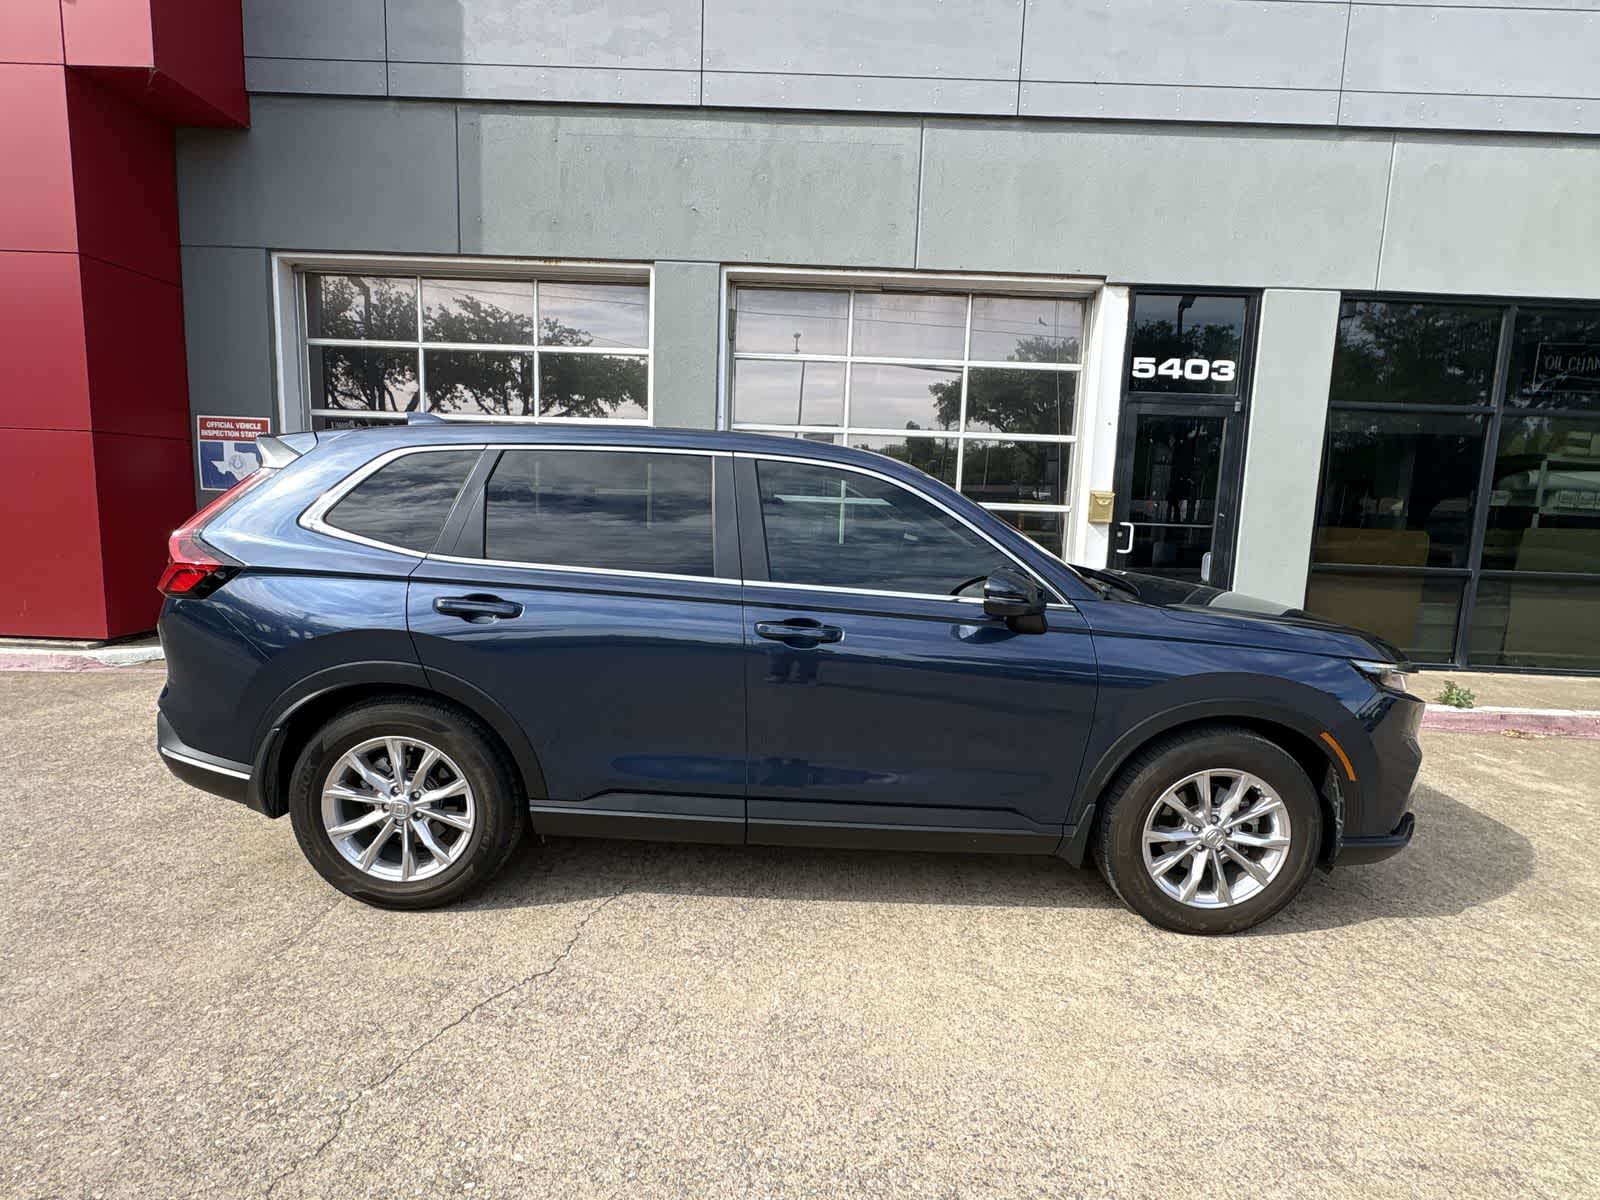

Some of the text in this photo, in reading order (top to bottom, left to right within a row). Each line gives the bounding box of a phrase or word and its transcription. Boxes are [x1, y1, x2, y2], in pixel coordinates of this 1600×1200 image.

[1132, 357, 1236, 382] 5403
[236, 422, 262, 430] VEHICLE
[201, 429, 240, 437] INSPECTION
